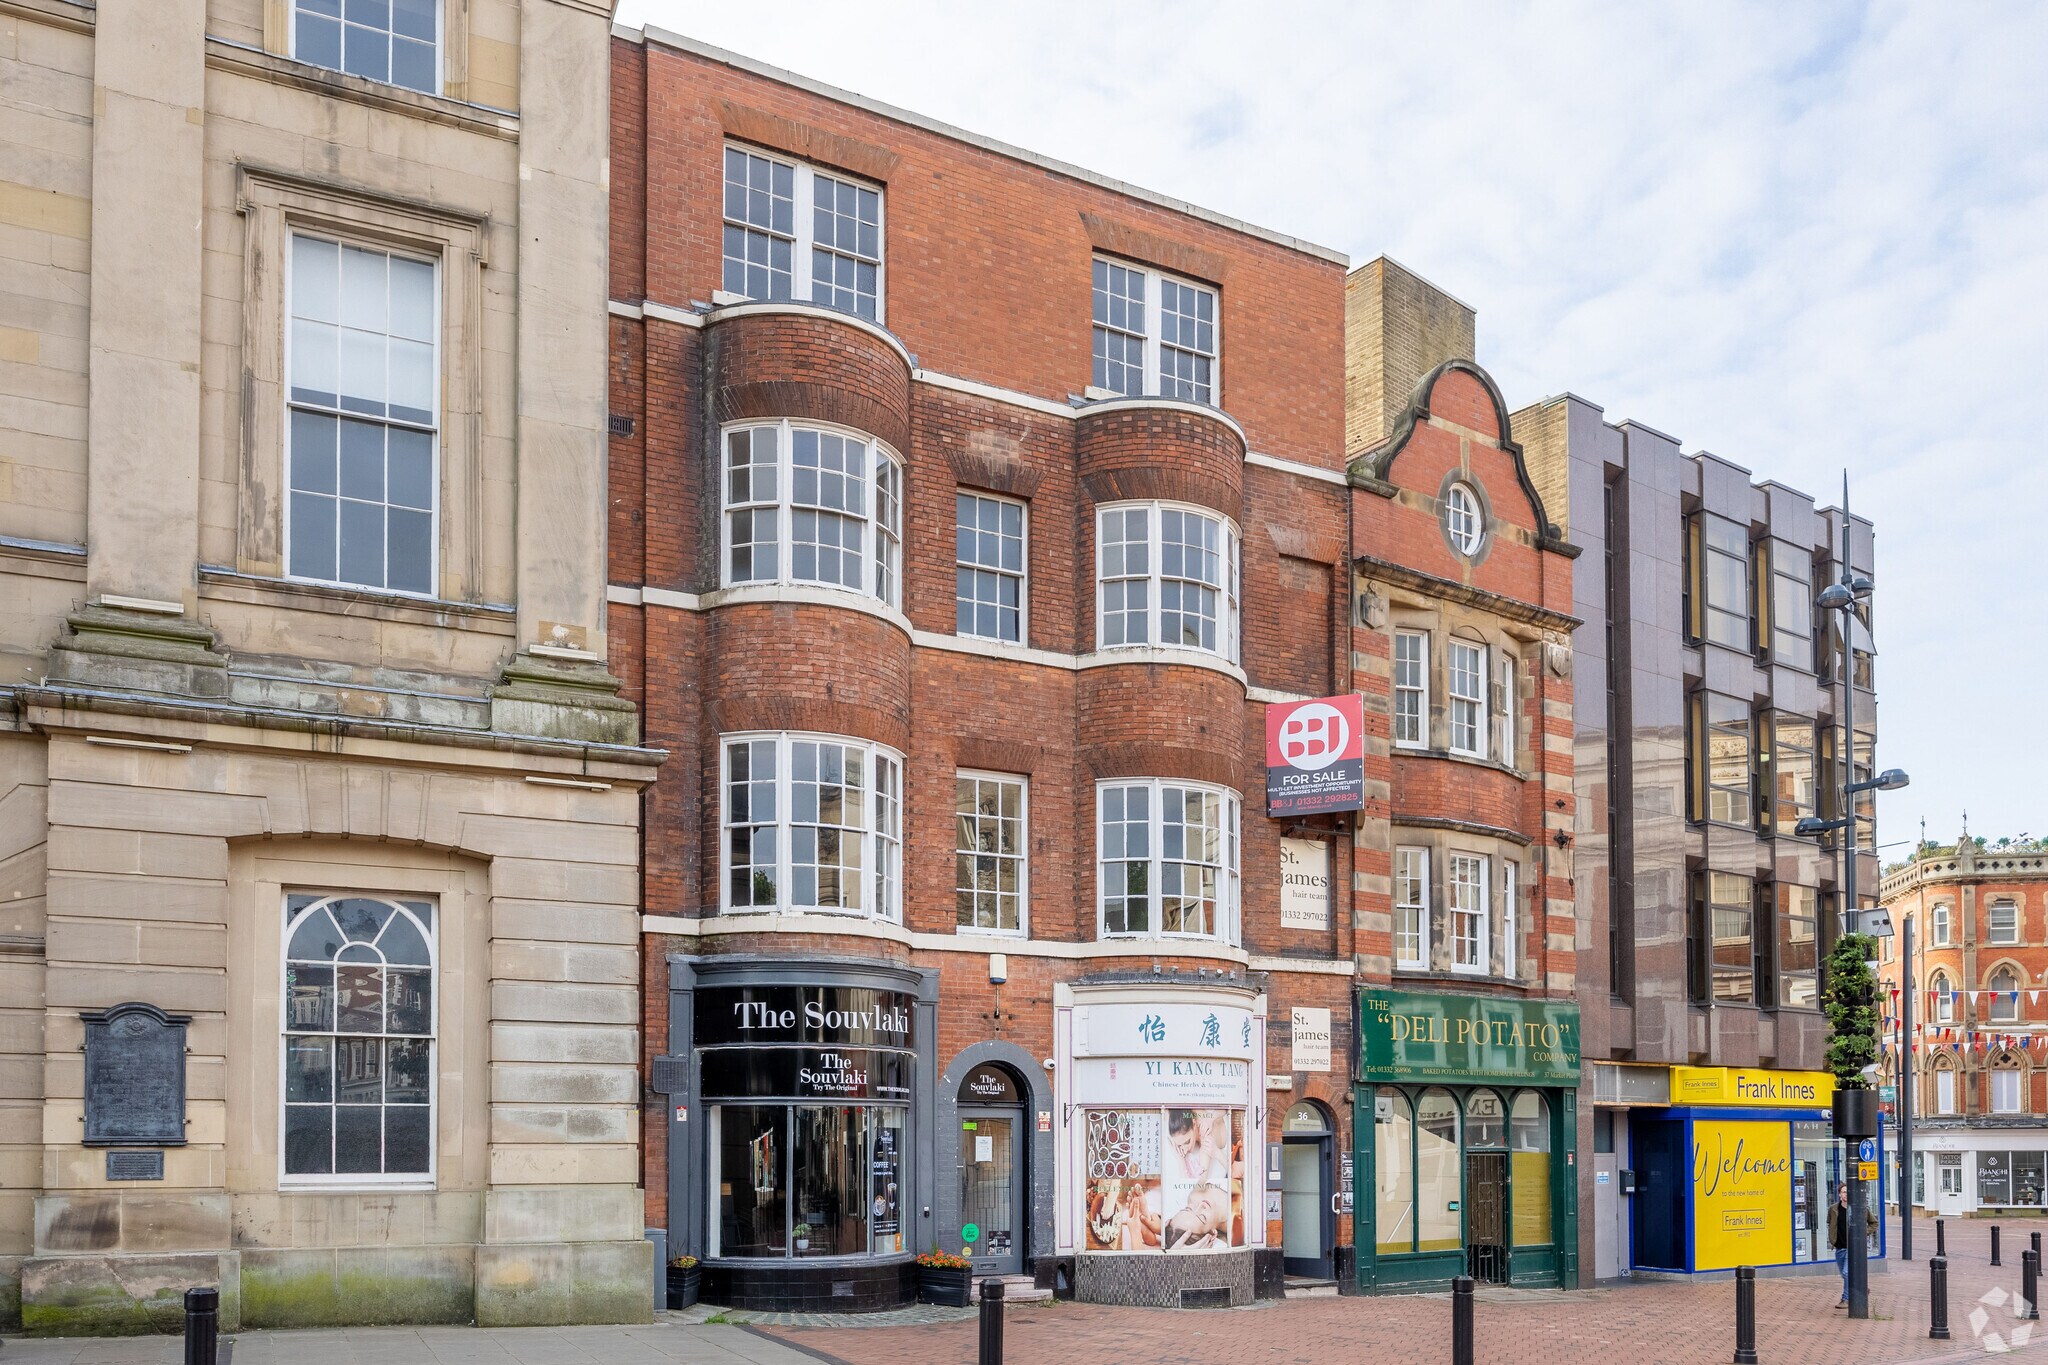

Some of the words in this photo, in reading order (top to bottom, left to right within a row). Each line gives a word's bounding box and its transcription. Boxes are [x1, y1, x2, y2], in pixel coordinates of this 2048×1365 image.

[1283, 774, 1309, 786] FOR
[1312, 770, 1346, 783] SALE
[1268, 785, 1293, 793] MULTI-LET
[1293, 782, 1325, 791] INVESTMENT
[1326, 779, 1362, 788] OPPORTUNITY
[1279, 789, 1310, 797] (BUSINESSES
[1322, 785, 1351, 793] AFFECTED)
[1271, 799, 1293, 809] BB&J
[1297, 796, 1322, 806] 01332
[1324, 793, 1358, 803] 292825
[1280, 846, 1299, 865] St.
[1280, 867, 1328, 888] james
[1293, 889, 1308, 899] hair
[1310, 892, 1328, 901] team
[1303, 911, 1328, 922] 297022
[1368, 999, 1389, 1011] THE
[734, 1001, 796, 1029] The
[804, 1001, 909, 1034] Souvlaki
[1294, 1012, 1309, 1025] St.
[1294, 1027, 1329, 1043] james
[820, 1053, 852, 1069] The
[1533, 1051, 1577, 1064] COMPANY
[800, 1067, 868, 1085] Souvlaki
[1145, 1061, 1161, 1075] YI
[1173, 1061, 1212, 1075] KANG
[1220, 1062, 1243, 1078] TANG
[1422, 1066, 1440, 1075] BAKED
[1440, 1067, 1469, 1075] POTATOES
[1484, 1069, 1514, 1077] HOMEMADE
[1514, 1070, 1535, 1078] FILLINGS
[980, 1074, 996, 1083] The
[813, 1084, 823, 1092] Try
[836, 1084, 857, 1092] Original
[970, 1082, 1005, 1092] Souvlaki
[1737, 1076, 1777, 1099] Frank
[1780, 1077, 1815, 1100] Innes
[1297, 1112, 1308, 1121] 36
[1693, 1132, 1791, 1197] Welcome
[1978, 1167, 2008, 1177] BIANCHI
[1725, 1215, 1744, 1226] Frank
[1745, 1214, 1763, 1225] Innes
